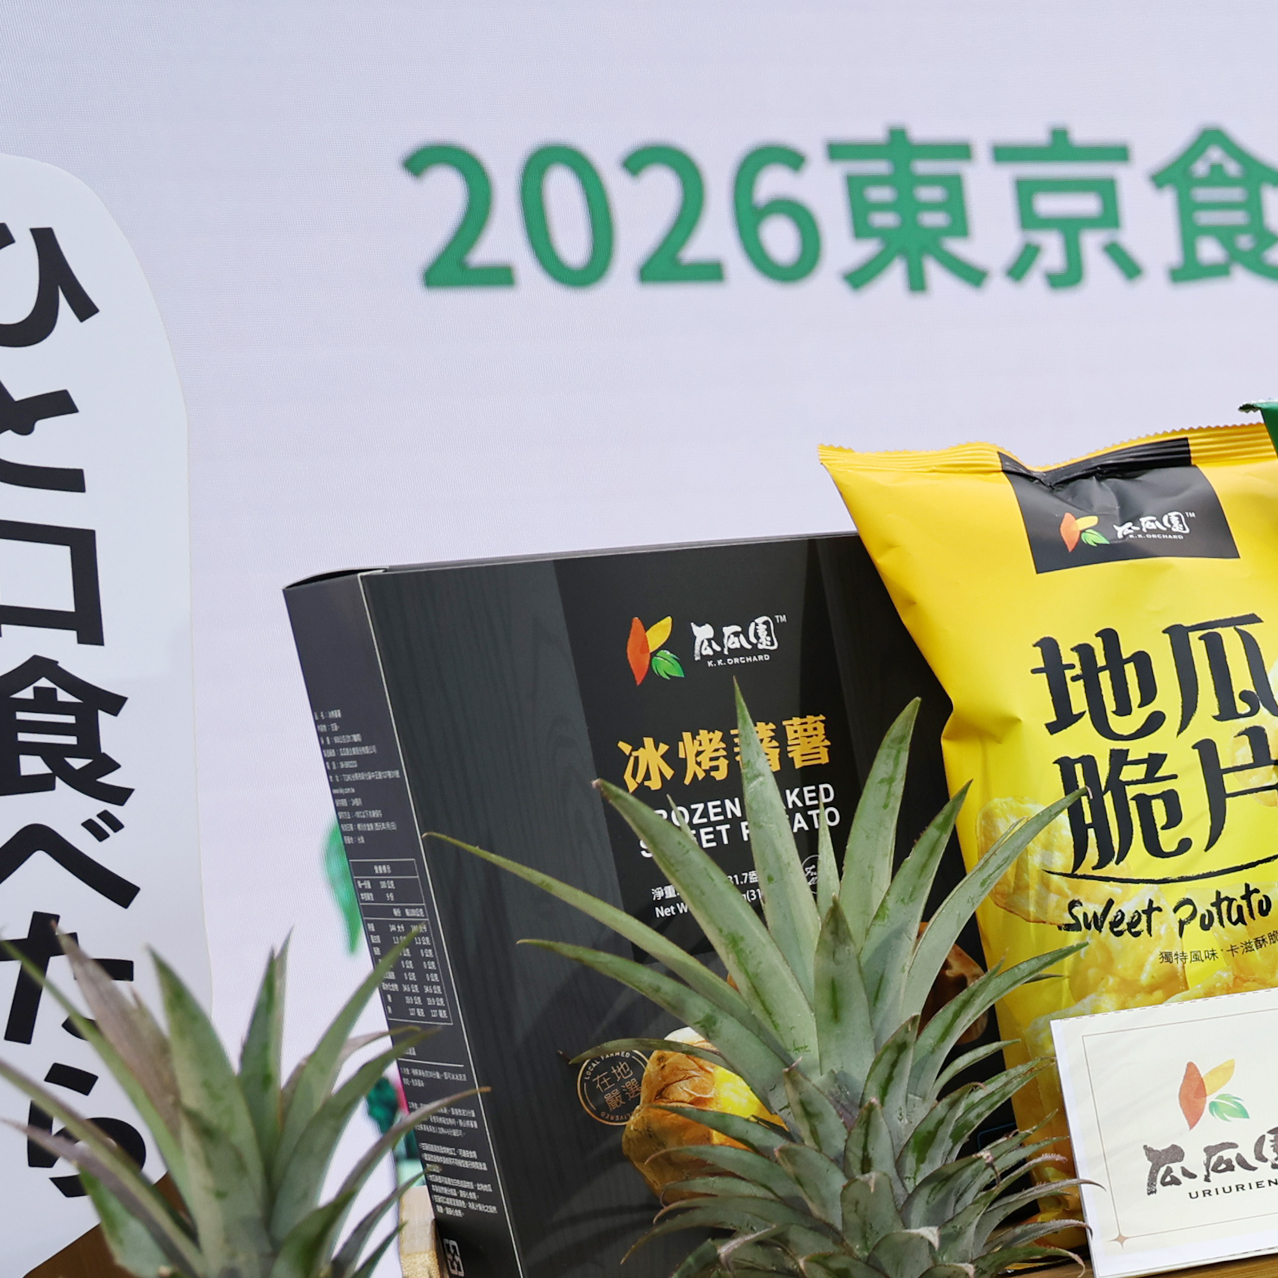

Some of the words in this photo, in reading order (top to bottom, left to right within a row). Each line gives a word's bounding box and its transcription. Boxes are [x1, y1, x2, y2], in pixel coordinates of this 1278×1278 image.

[690, 615, 778, 661] 瓜瓜園
[1188, 1178, 1278, 1200] URIURIEN
